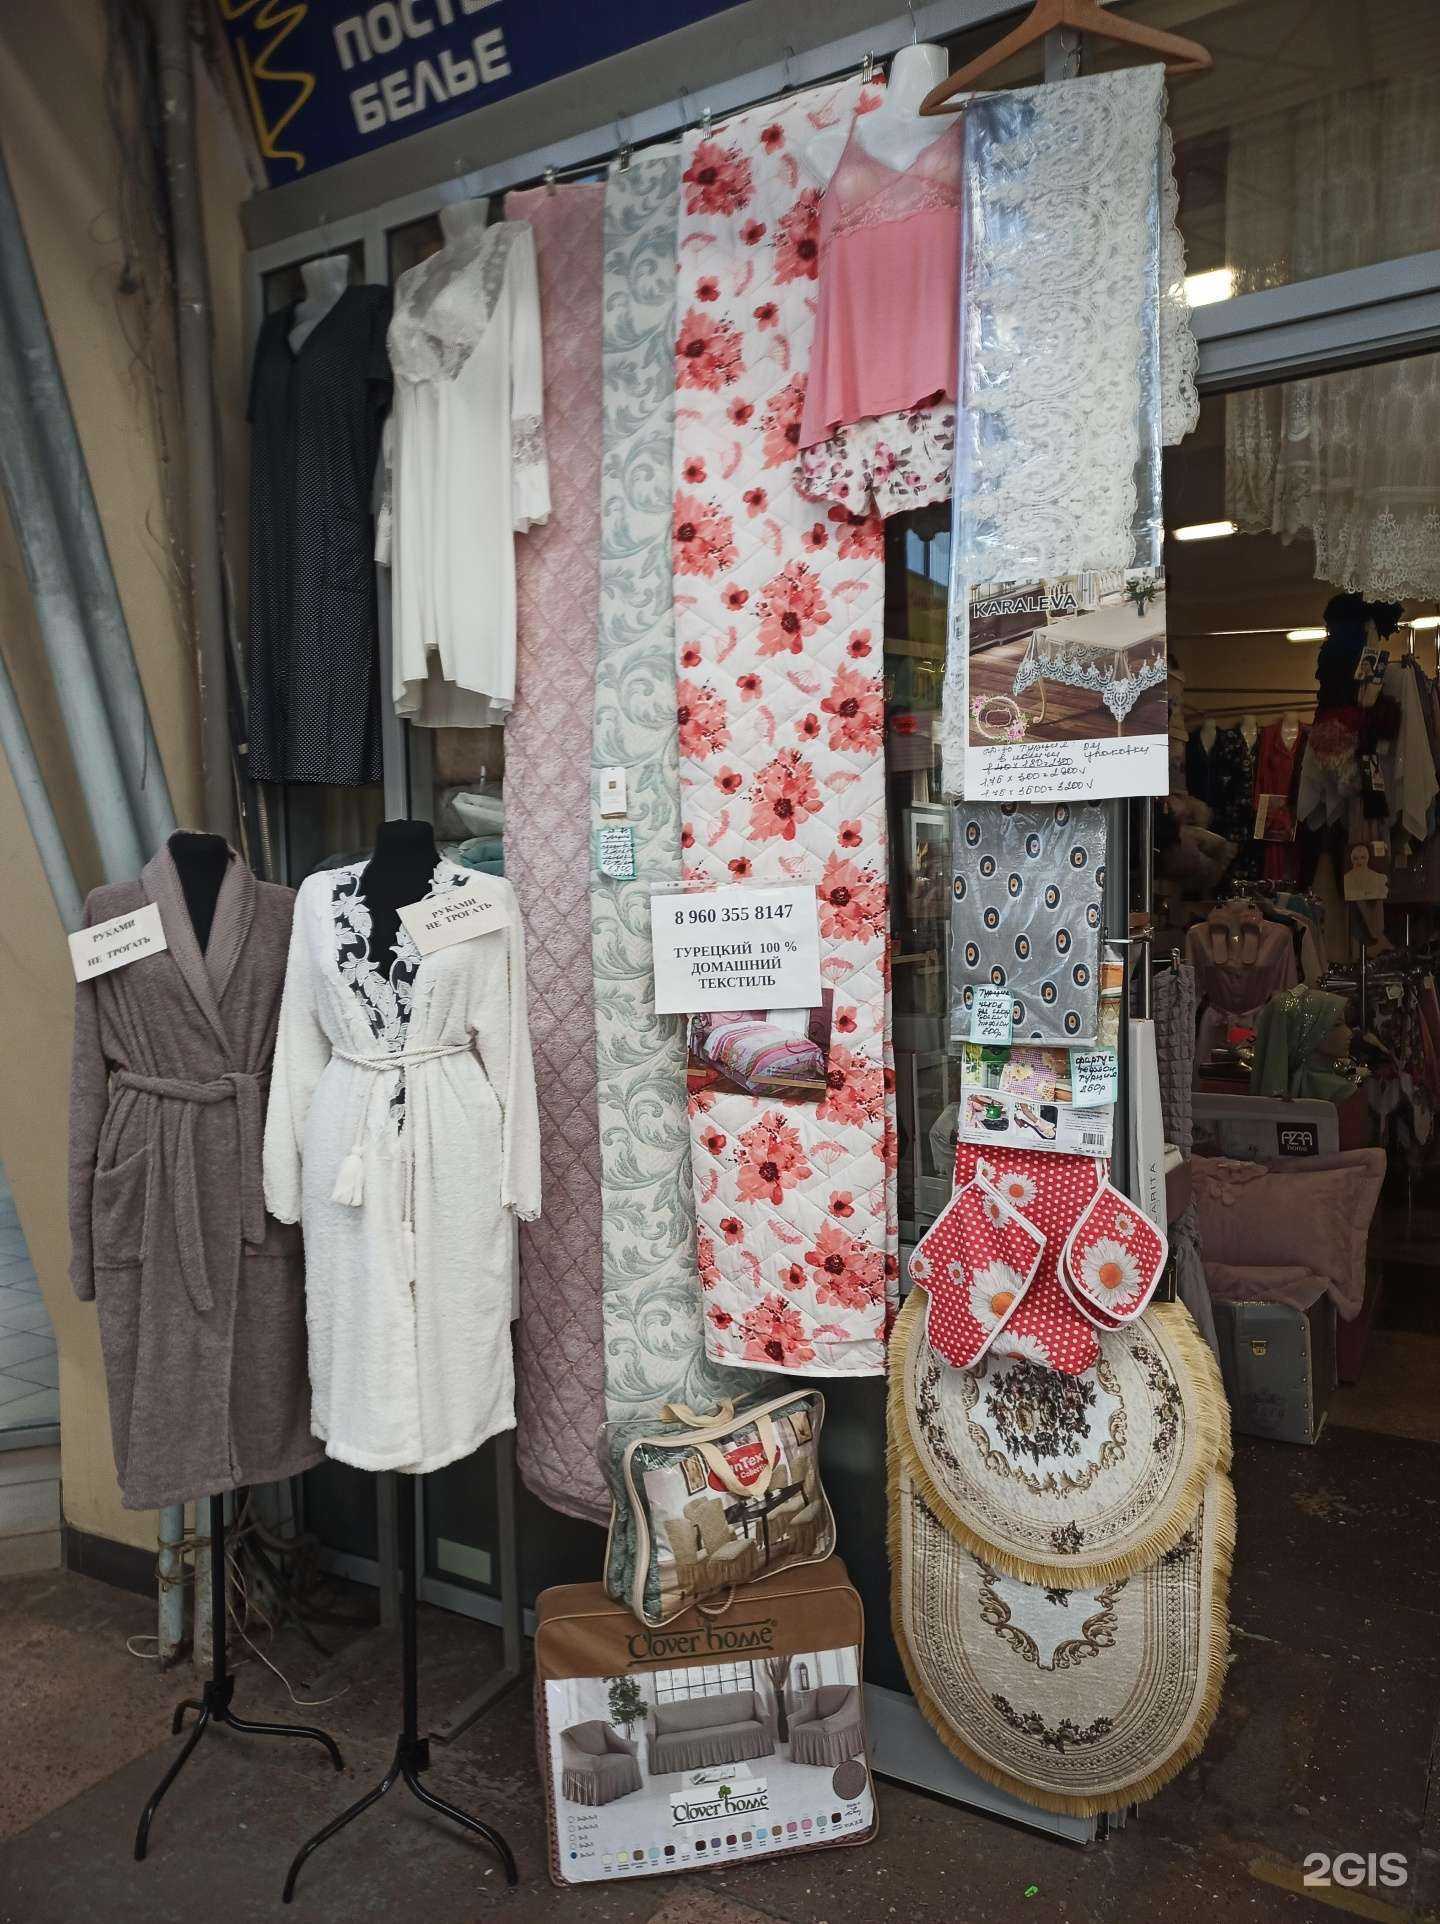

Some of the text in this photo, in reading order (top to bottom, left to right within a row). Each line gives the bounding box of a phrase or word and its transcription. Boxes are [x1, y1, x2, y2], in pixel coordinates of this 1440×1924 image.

[349, 27, 512, 134] БЕЛЬЕ
[973, 593, 1077, 618] KARALEVA
[425, 903, 492, 930] НЕ ТРОГАТЬ
[432, 899, 477, 918] РУКАМИ
[675, 904, 793, 924] 8 960 355 8147
[93, 919, 136, 942] РУКАМИ
[88, 937, 151, 966] НЕ ТРОГАТЬ
[673, 941, 797, 958] ТУРЕЦКИЙ 100 %
[691, 956, 782, 975] ДОМАШНИЙ
[698, 975, 776, 989] ТЕКСТИЛЬ
[625, 1621, 772, 1659] Clover home
[670, 1794, 768, 1821] Clover home
